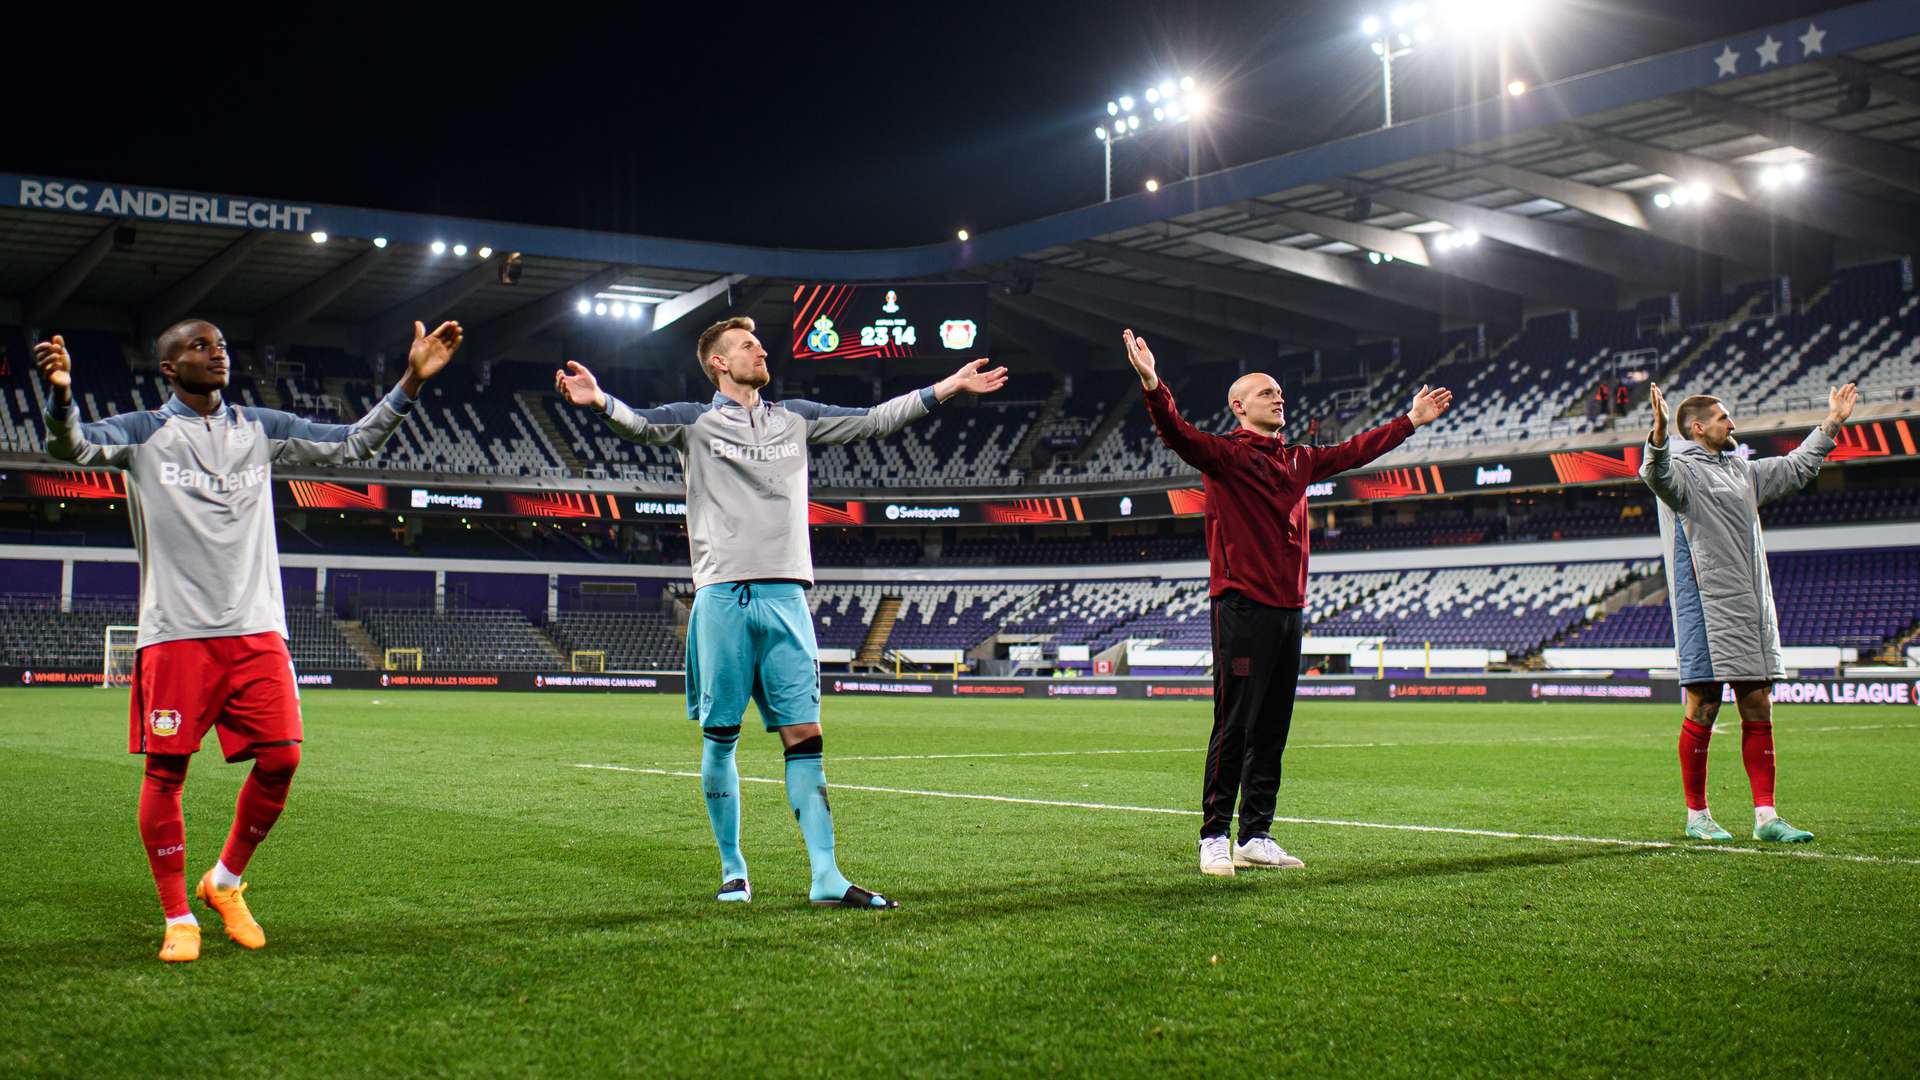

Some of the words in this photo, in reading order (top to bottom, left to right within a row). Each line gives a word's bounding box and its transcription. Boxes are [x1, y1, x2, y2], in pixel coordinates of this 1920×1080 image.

[20, 180, 88, 210] RSC
[94, 188, 312, 231] ANDERLECHT
[861, 327, 889, 346] 23
[892, 327, 917, 346] 14
[709, 440, 801, 461] Barmenia
[160, 462, 266, 491] Barmenia
[1476, 464, 1511, 485] bwin
[635, 502, 664, 514] UEFA
[666, 503, 687, 515] EUR
[900, 506, 960, 520] Swissquote
[34, 673, 66, 683] WHERE
[1832, 683, 1909, 703] LEAGUE
